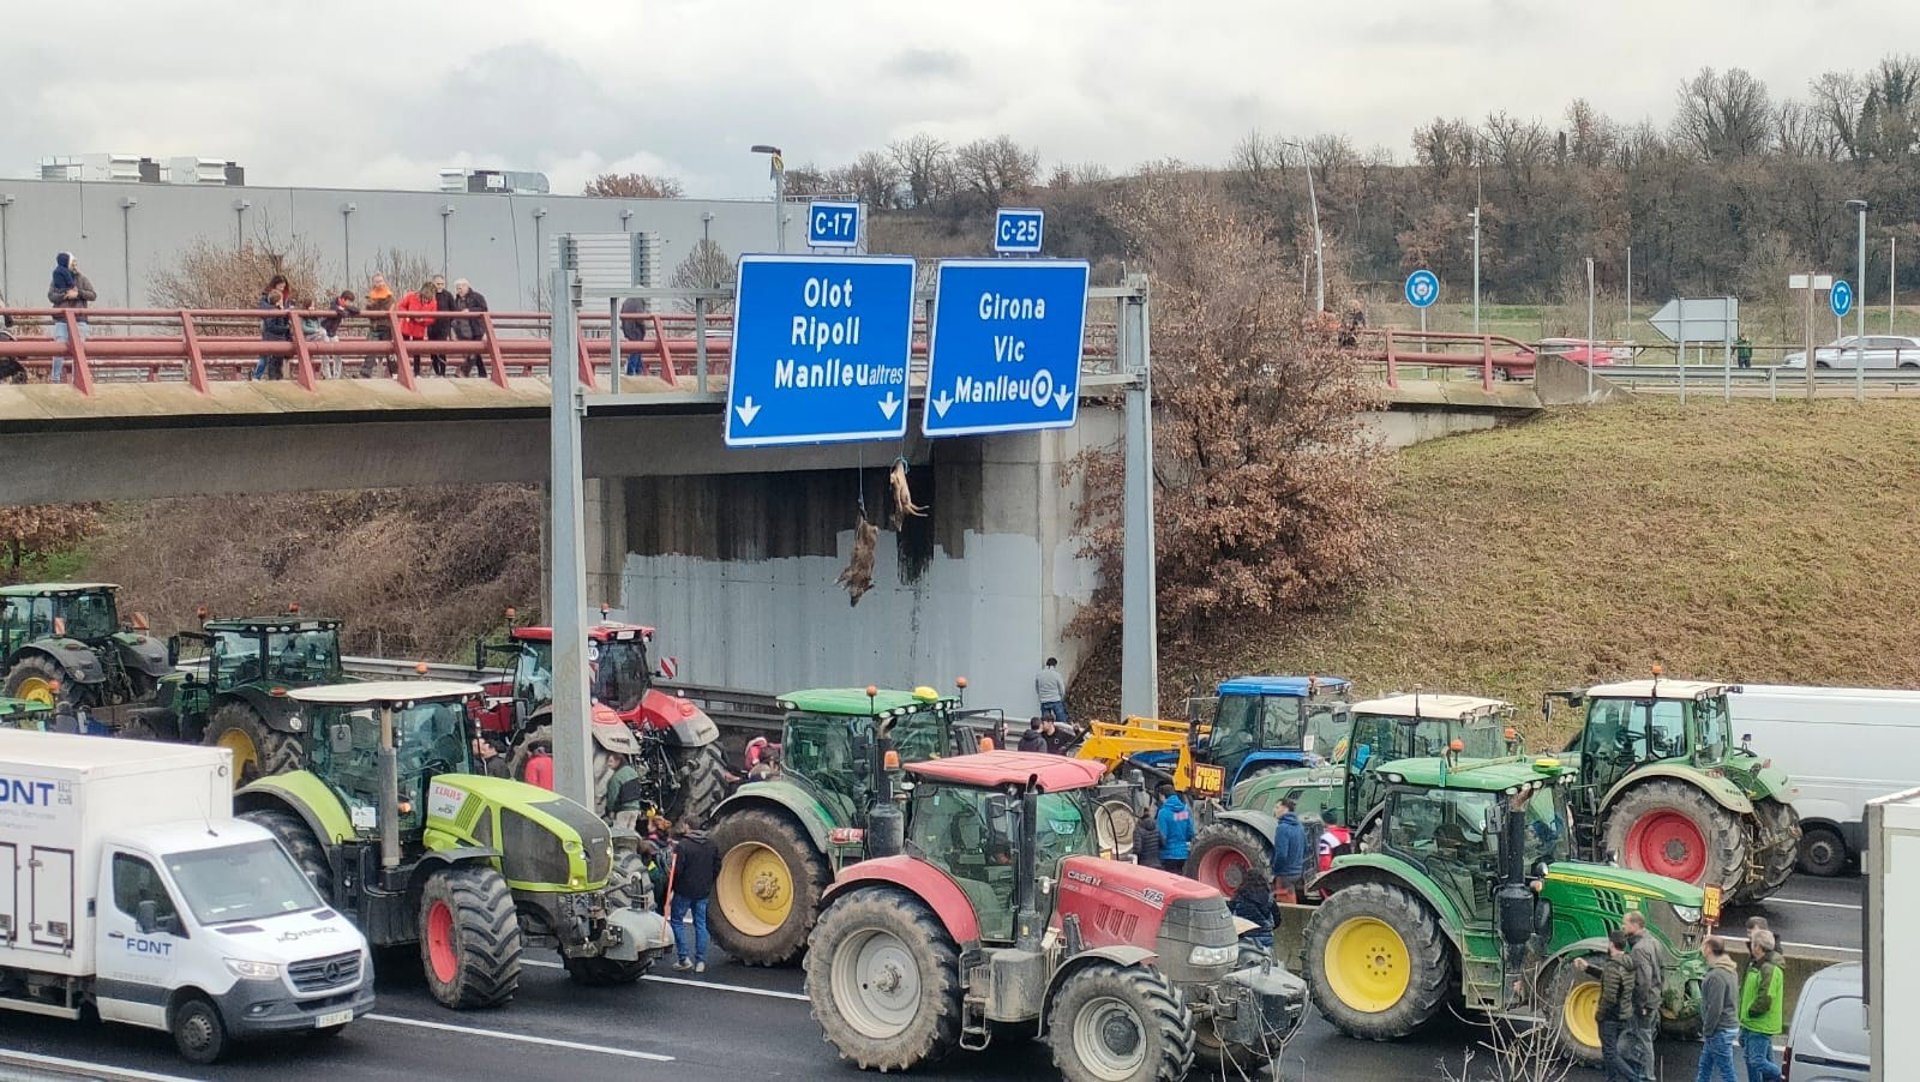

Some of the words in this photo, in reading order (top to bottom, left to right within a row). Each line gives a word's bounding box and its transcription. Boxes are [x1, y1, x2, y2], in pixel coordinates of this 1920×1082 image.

[815, 211, 853, 236] C-17
[1001, 219, 1038, 242] C-25
[804, 277, 853, 308] Olot
[979, 291, 1046, 320] Girona
[791, 315, 860, 353] Ripoll
[994, 335, 1026, 363] Vic
[774, 358, 869, 389] Manlleu
[868, 364, 904, 385] altres
[954, 375, 1031, 404] Manlleu
[1067, 870, 1093, 885] CASE
[127, 937, 172, 956] FONT
